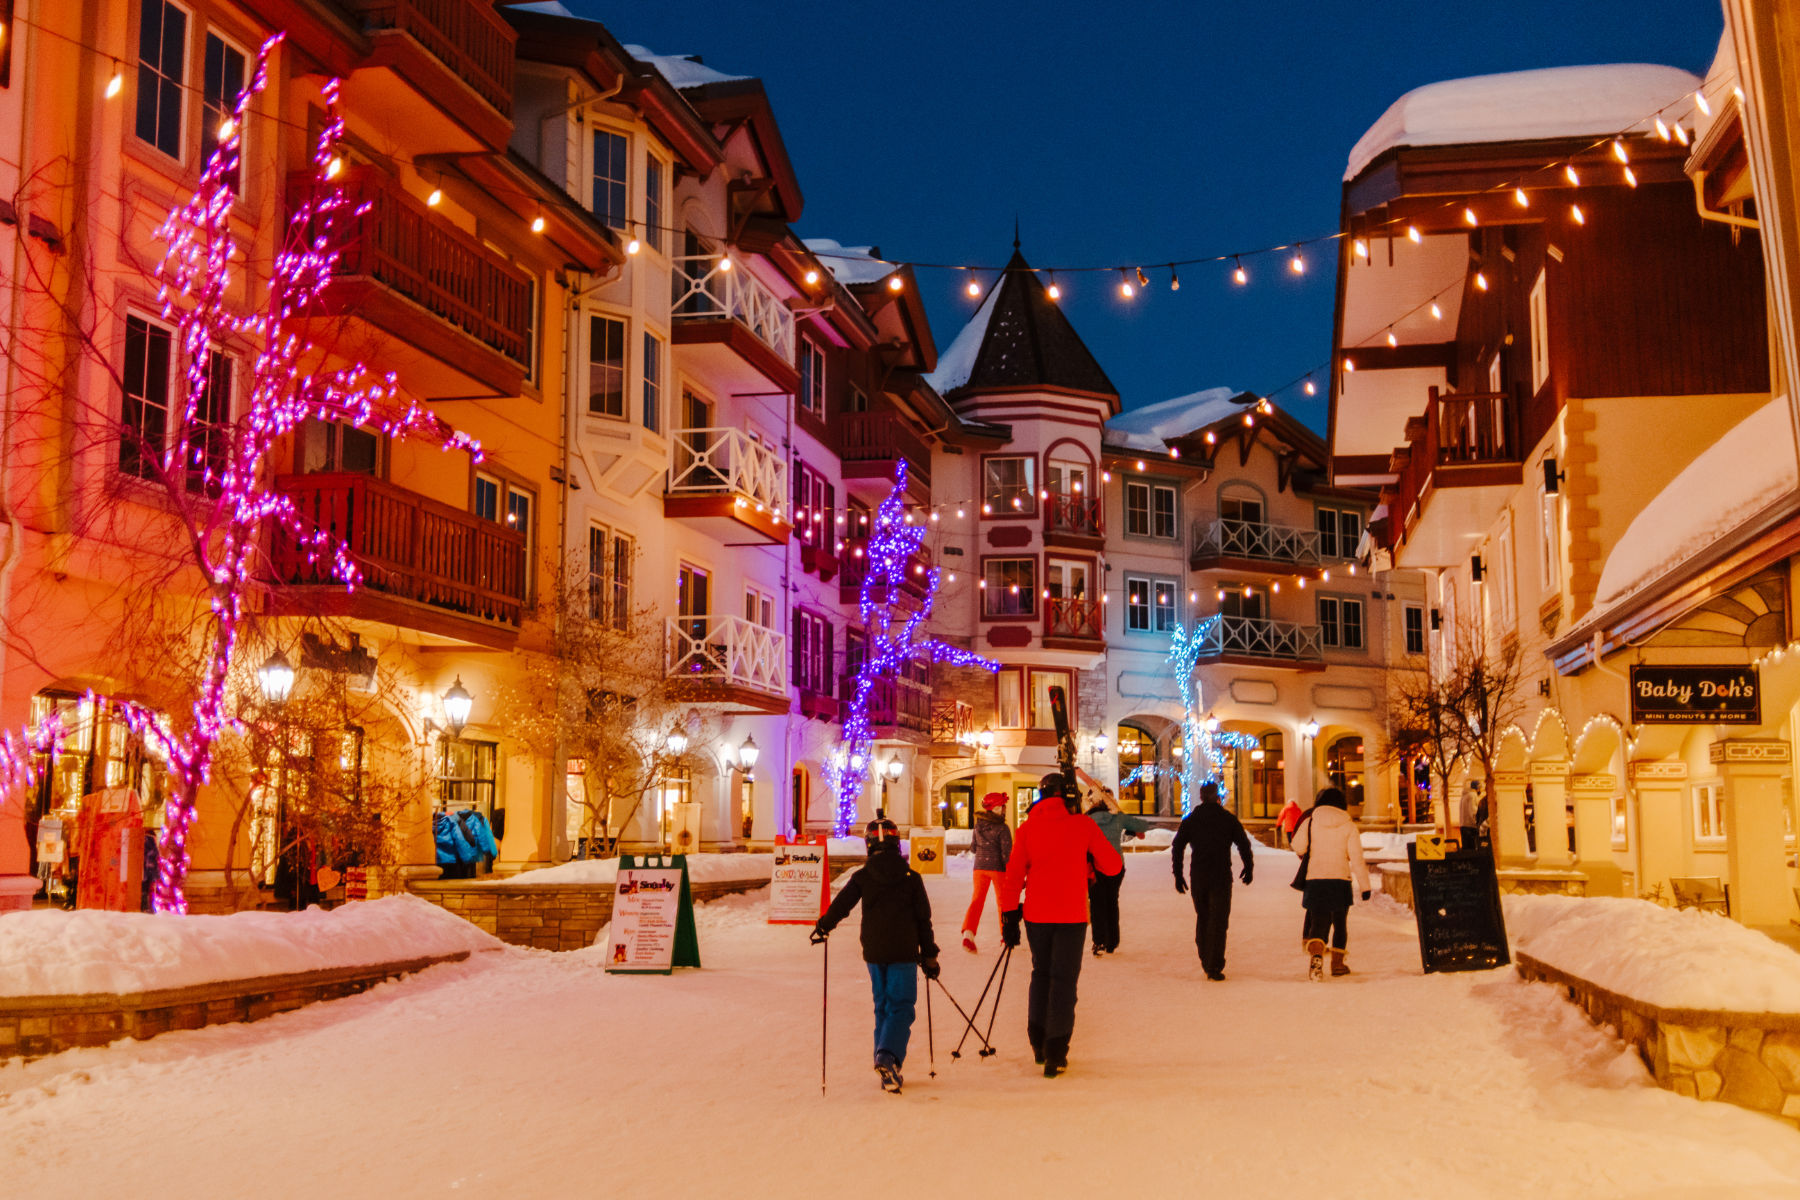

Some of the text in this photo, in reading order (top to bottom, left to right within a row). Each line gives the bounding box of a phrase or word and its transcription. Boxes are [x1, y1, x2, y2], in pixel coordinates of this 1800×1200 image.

[1636, 679, 1754, 704] Baby Doh's
[798, 869, 819, 879] WALL
